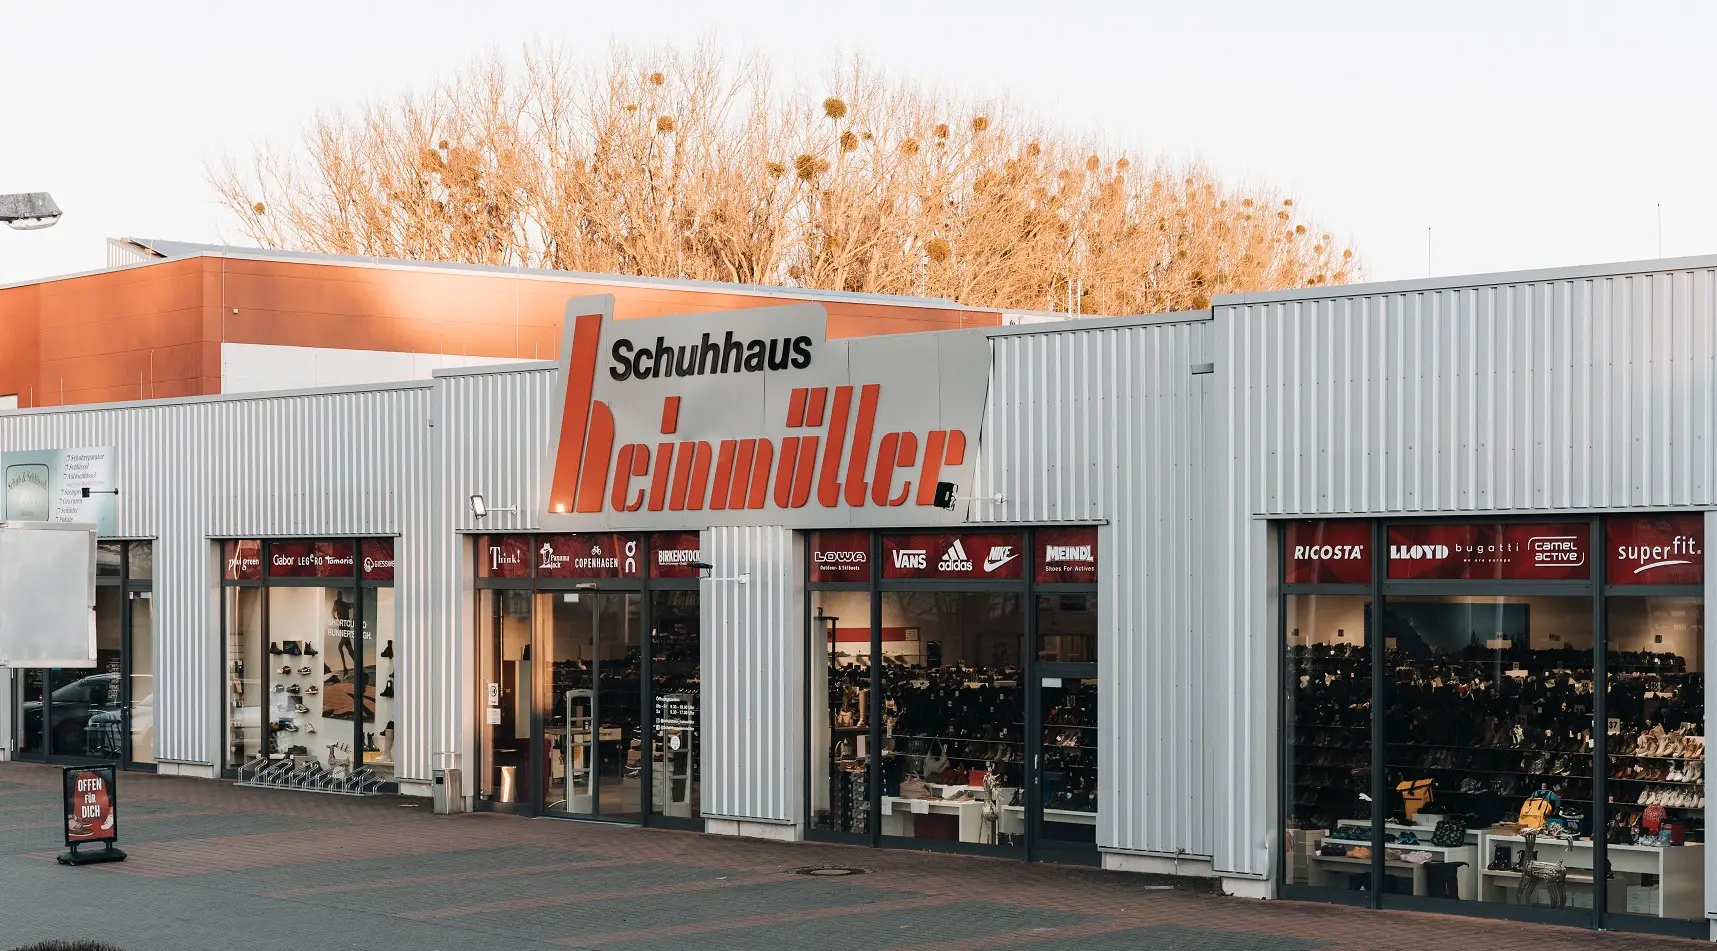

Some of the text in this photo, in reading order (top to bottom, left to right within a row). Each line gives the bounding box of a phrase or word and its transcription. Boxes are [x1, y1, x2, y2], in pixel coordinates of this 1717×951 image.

[609, 330, 812, 382] Schuhhaus
[548, 314, 967, 513] heinmüller
[988, 546, 1014, 561] NIKE
[1045, 544, 1095, 563] MEINDL
[1294, 545, 1364, 560] RICOSTA
[1390, 544, 1449, 560] LLOYD
[1455, 543, 1519, 553] bugatti
[273, 554, 295, 566] Gabor
[489, 546, 521, 570] Think!
[550, 554, 570, 562] Panama
[574, 558, 619, 569] COPENHAGEN
[814, 551, 867, 563] LOWA
[892, 549, 927, 570] VANS
[242, 558, 260, 571] green
[938, 560, 973, 571] adidas
[327, 618, 355, 628] SHORTCU
[1608, 721, 1618, 729] 37
[78, 778, 102, 791] OFFEN
[84, 793, 96, 803] FÜR
[82, 805, 100, 818] DICH
